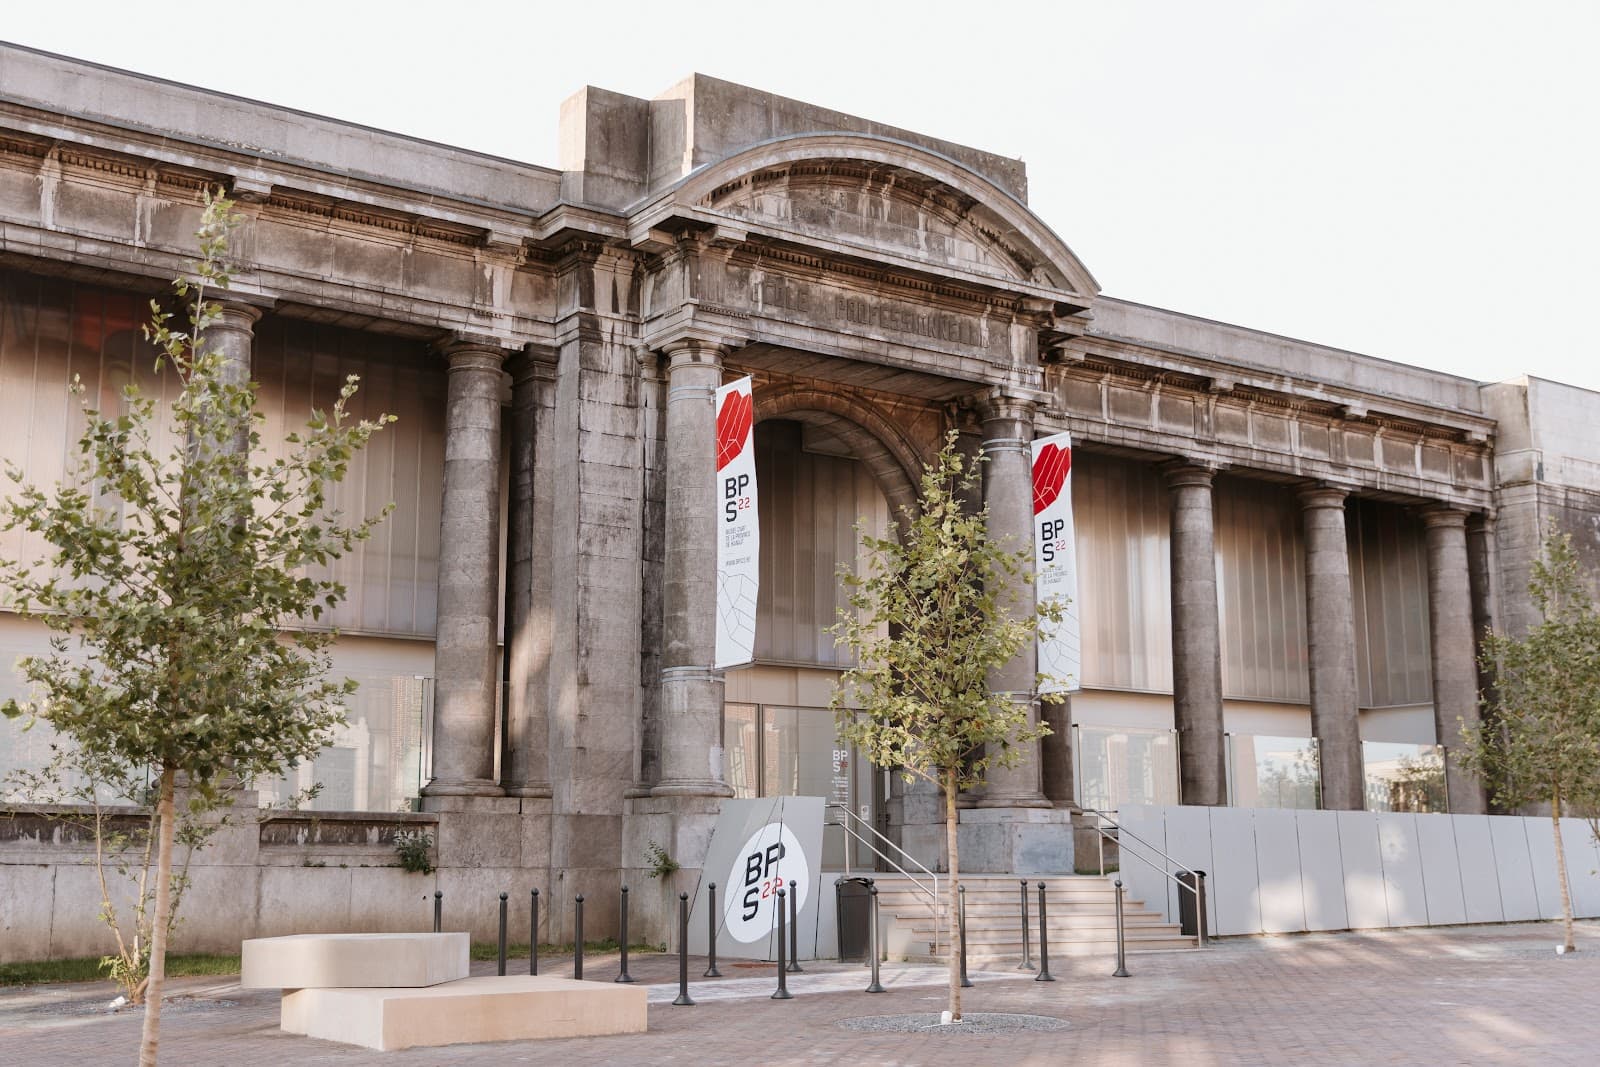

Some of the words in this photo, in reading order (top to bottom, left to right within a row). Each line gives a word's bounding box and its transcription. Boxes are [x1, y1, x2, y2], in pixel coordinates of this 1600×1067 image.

[726, 474, 749, 500] BP
[1041, 519, 1065, 541] BP
[832, 749, 848, 761] BP
[745, 842, 786, 887] BP
